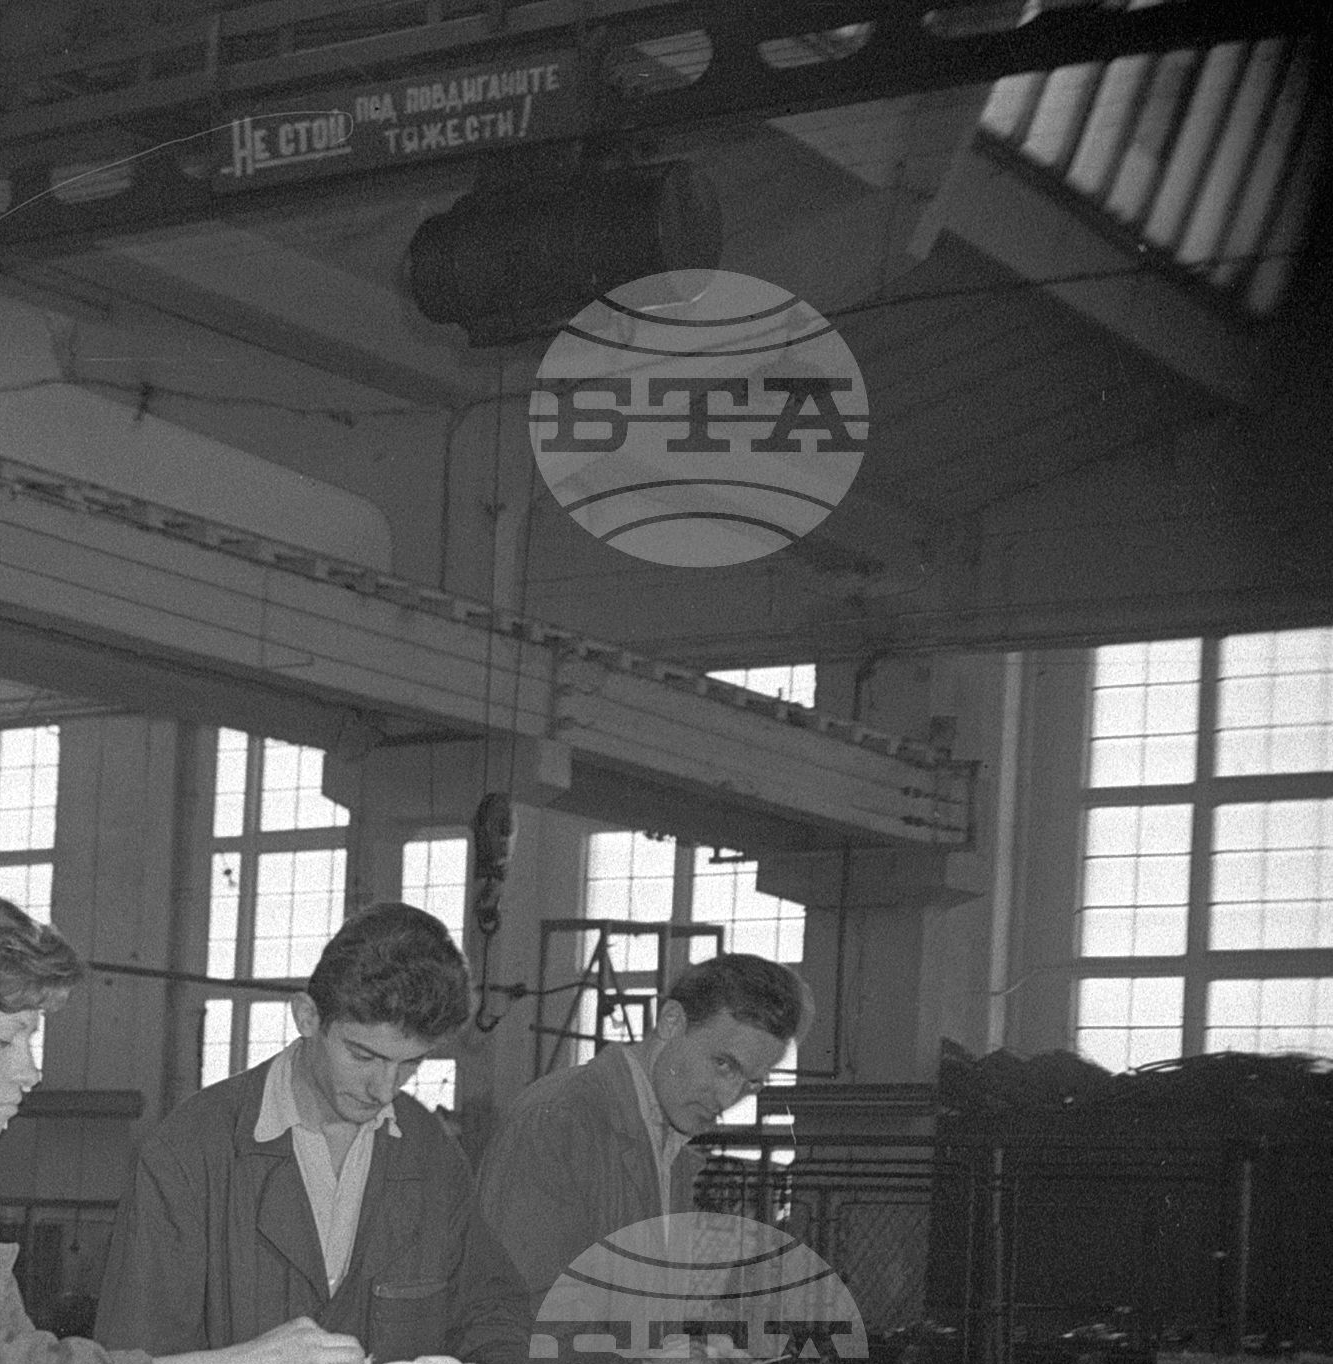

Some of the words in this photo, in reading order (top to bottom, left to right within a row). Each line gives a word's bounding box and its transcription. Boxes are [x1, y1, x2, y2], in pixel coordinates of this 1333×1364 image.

[355, 92, 397, 123] ПОД
[384, 95, 533, 153] ТЯЖЕСТИ!
[279, 109, 345, 156] СТОЙ
